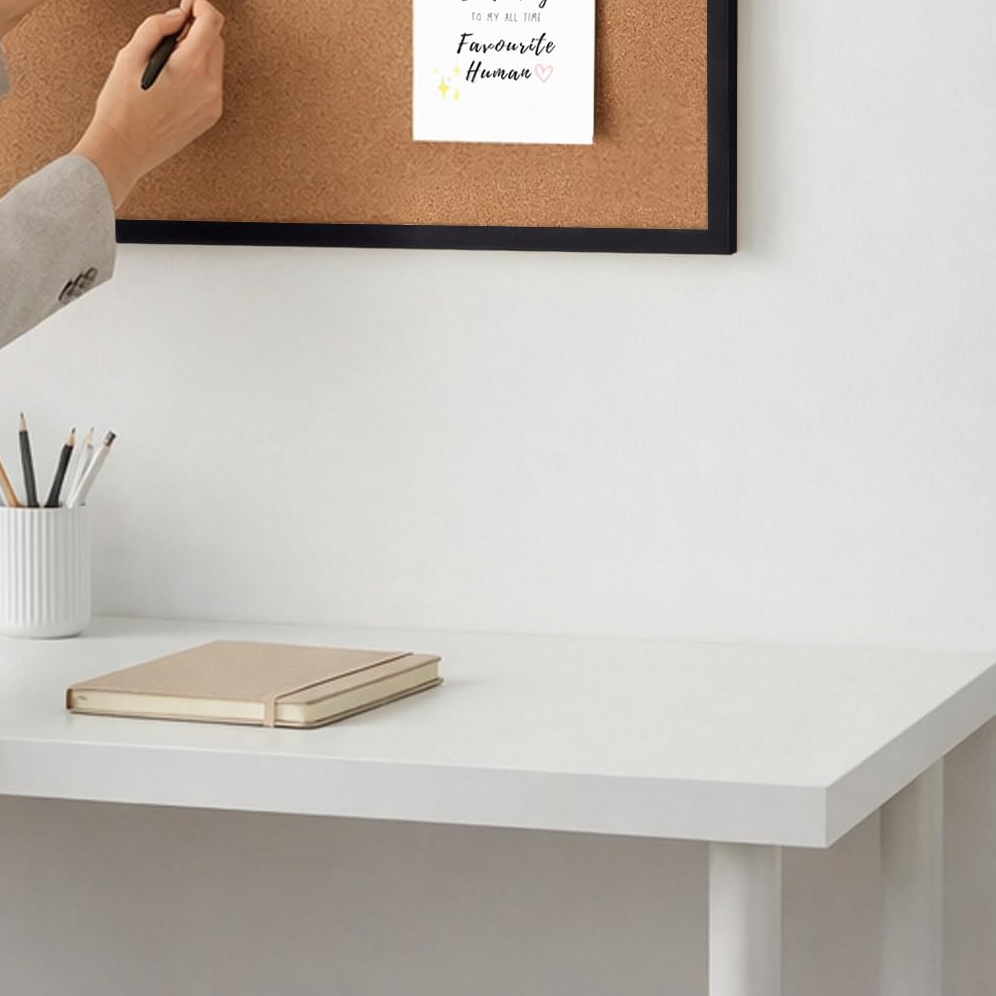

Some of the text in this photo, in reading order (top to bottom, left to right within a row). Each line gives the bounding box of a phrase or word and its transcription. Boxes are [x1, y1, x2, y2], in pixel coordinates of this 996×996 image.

[471, 12, 541, 22] TO MY ALL TIME
[456, 32, 556, 56] Favourite
[465, 60, 532, 83] Human
